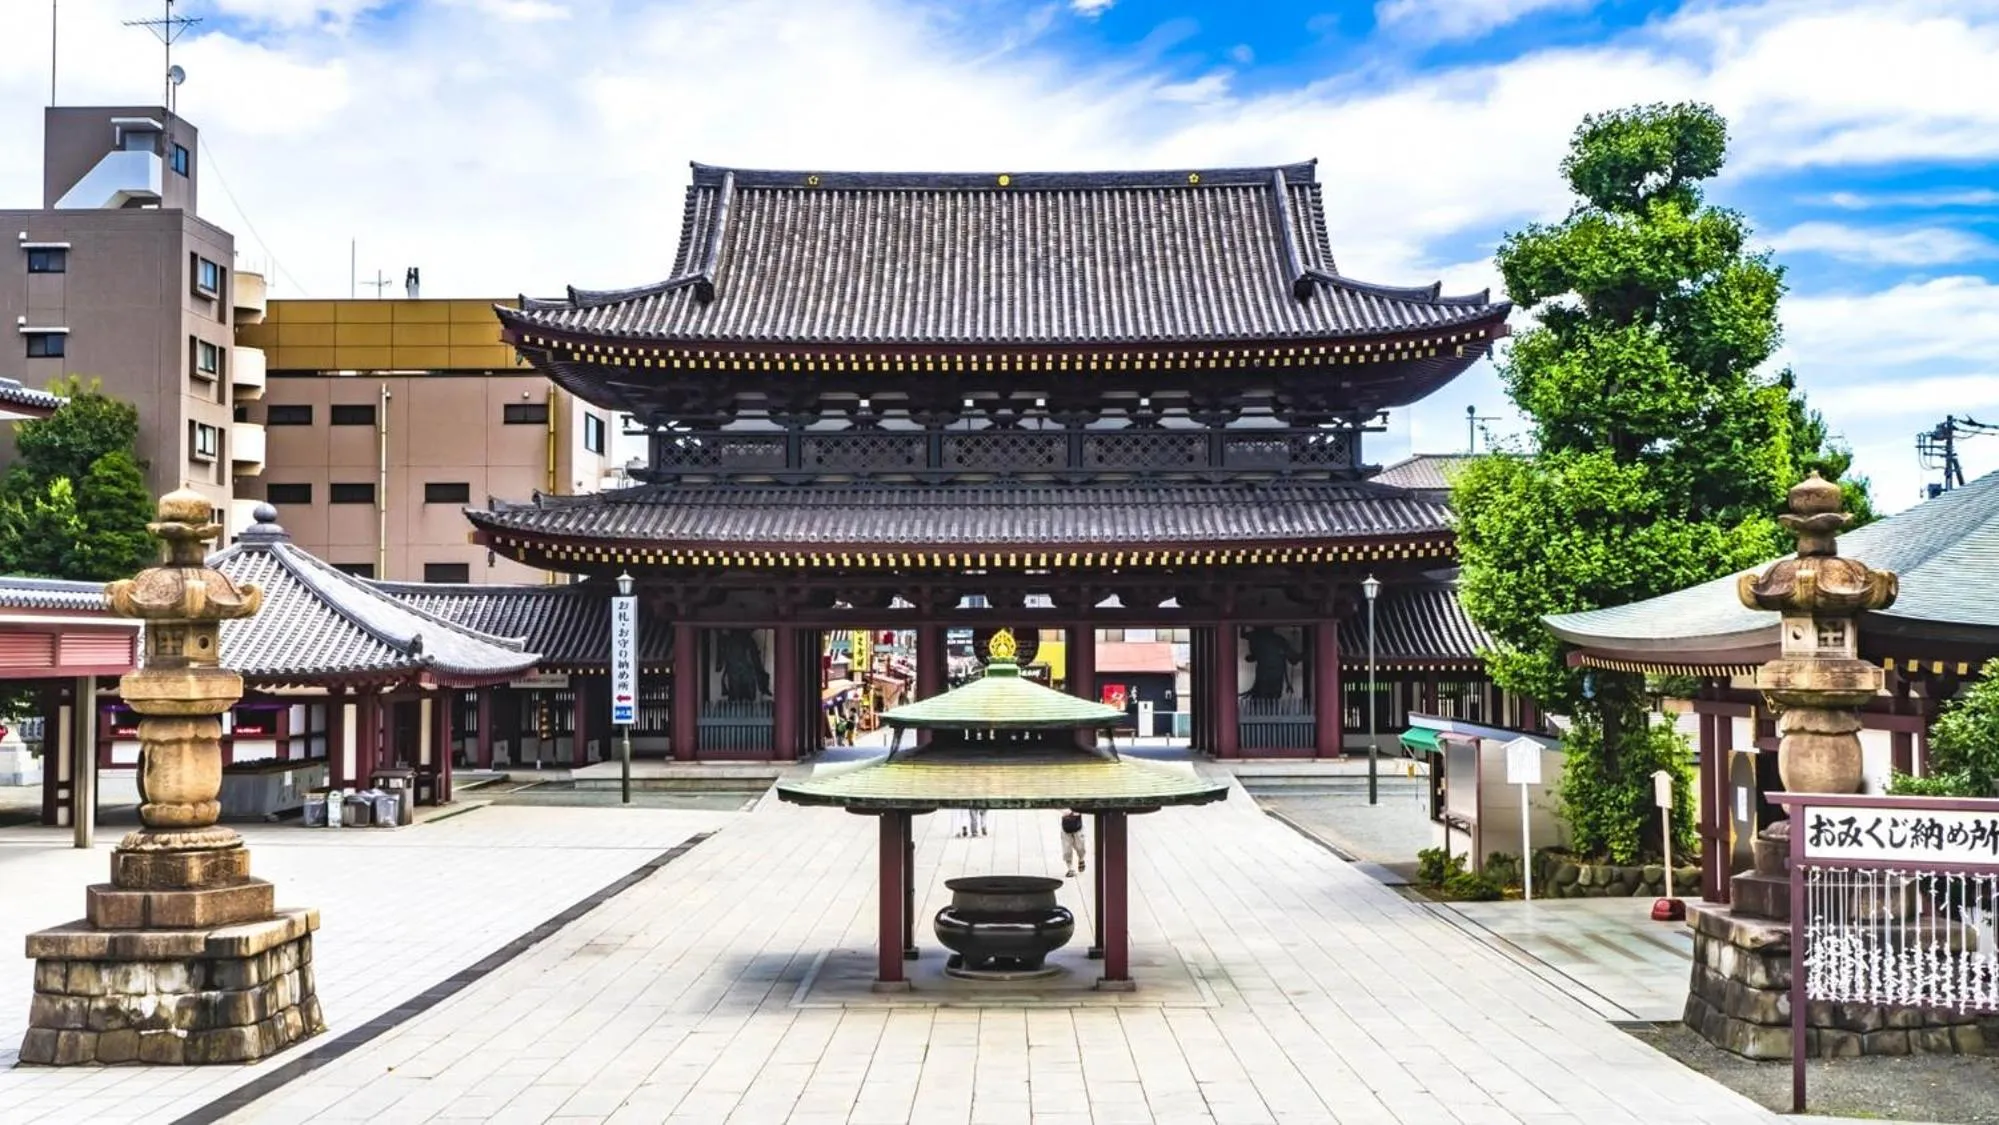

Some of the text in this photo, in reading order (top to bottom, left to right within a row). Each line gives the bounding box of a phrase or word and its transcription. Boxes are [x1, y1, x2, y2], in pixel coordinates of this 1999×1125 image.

[617, 601, 630, 691] お札・お守り納め所
[1809, 814, 1999, 855] おみくじ納め所
